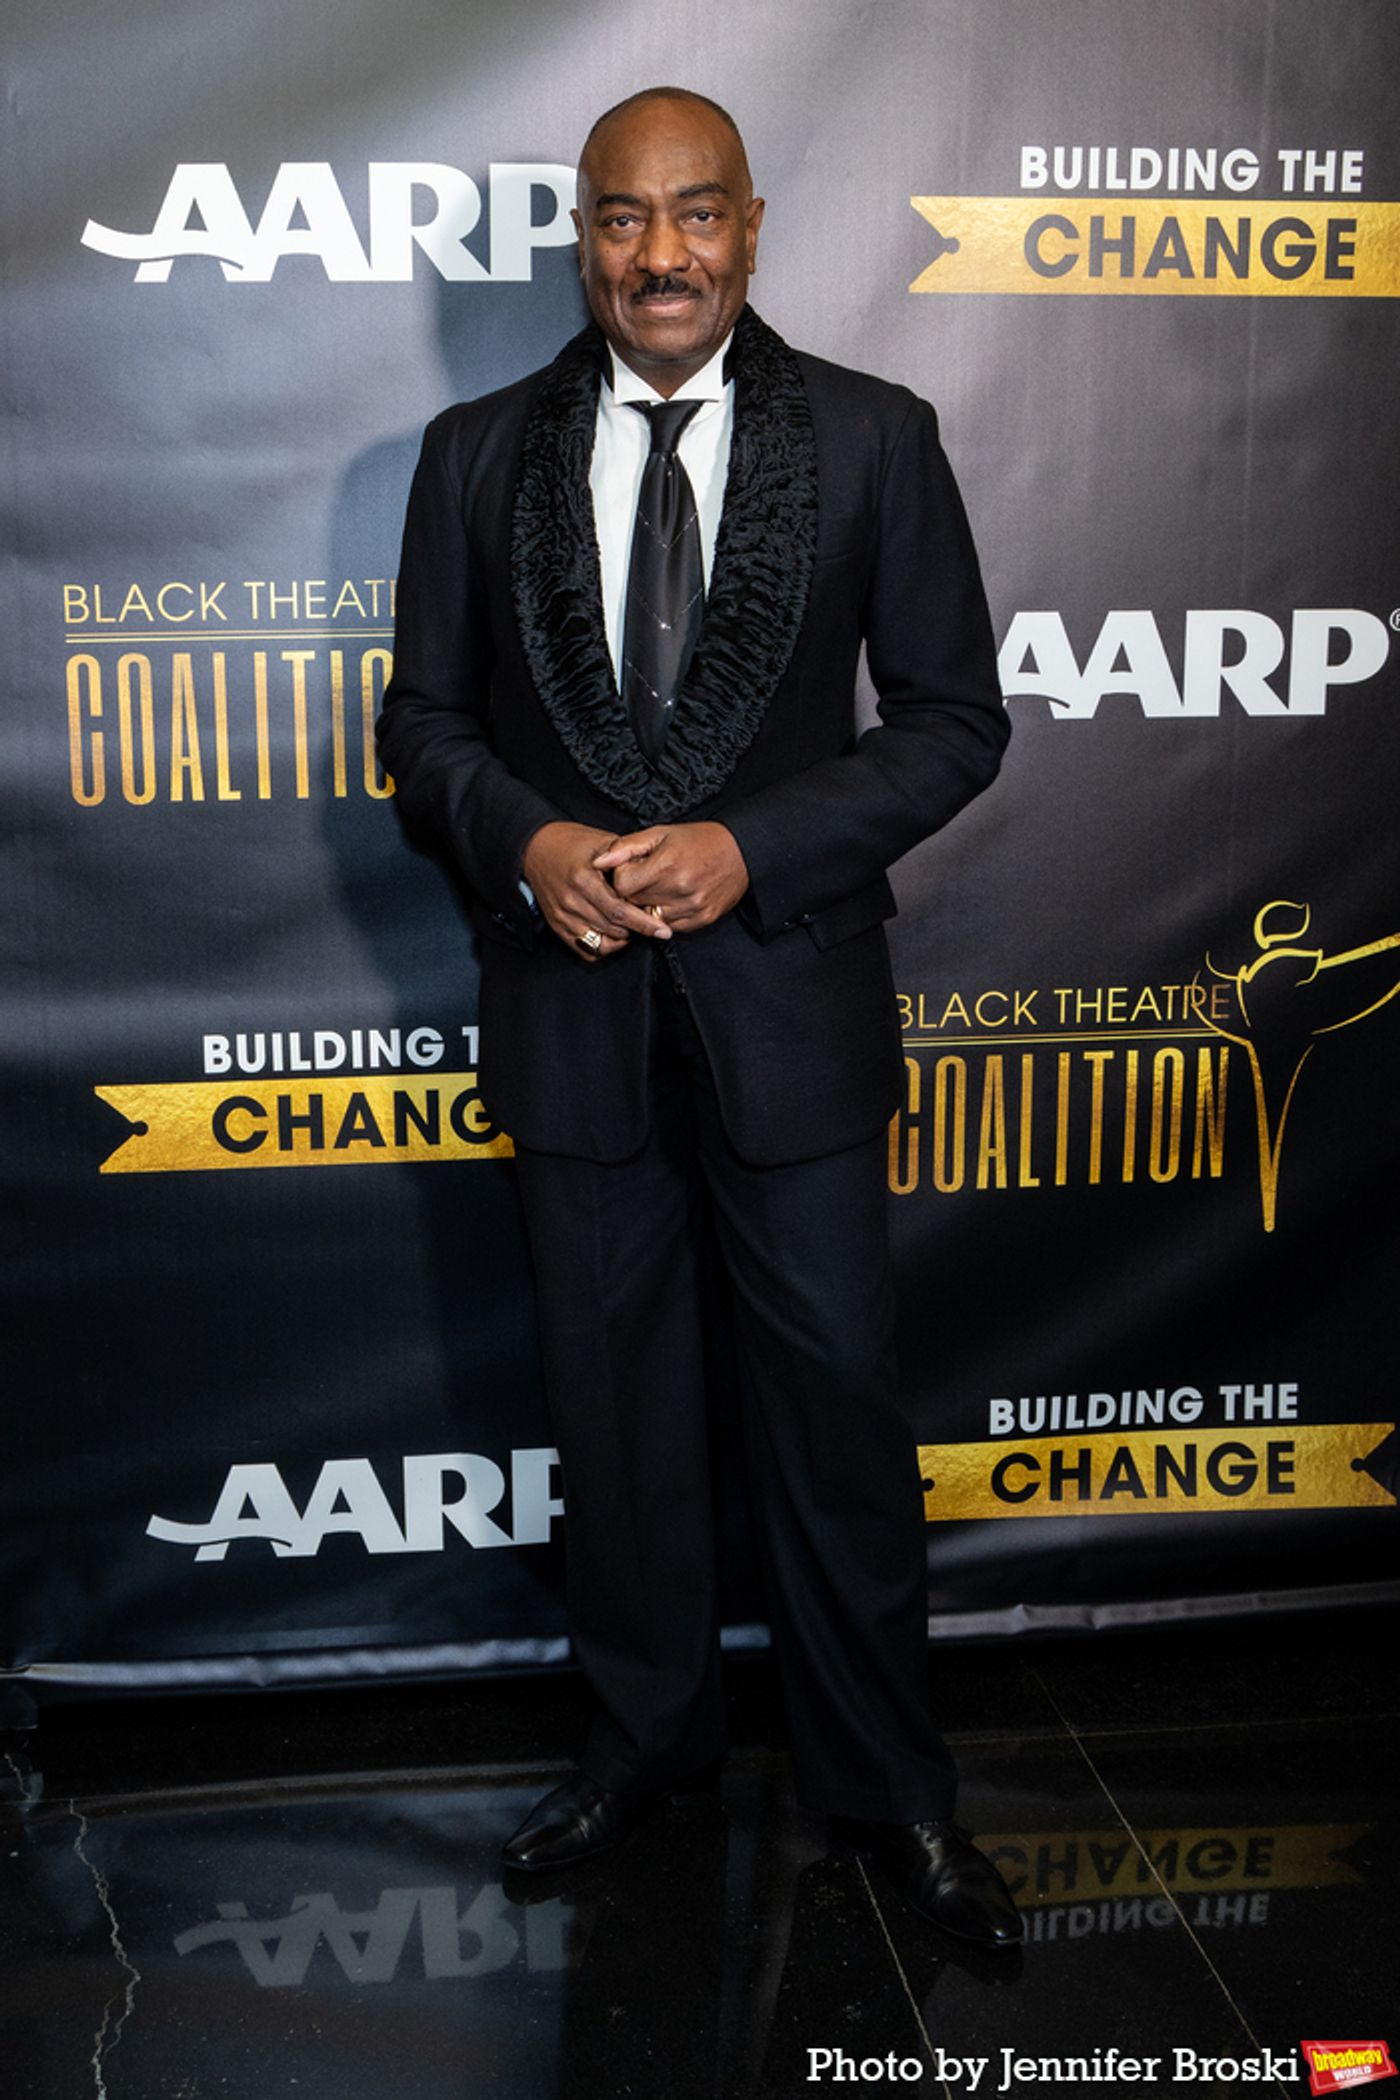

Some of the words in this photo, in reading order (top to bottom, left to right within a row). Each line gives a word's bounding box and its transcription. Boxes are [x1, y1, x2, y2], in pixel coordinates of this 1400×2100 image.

[1019, 146, 1260, 192] BUILDING
[1278, 149, 1364, 193] THE
[80, 161, 578, 283] AARP
[1023, 213, 1358, 281] CHANGE
[63, 582, 227, 624] BLACK
[243, 579, 396, 620] THEAT
[65, 648, 396, 807] COALITIO
[896, 989, 1040, 1030] BLACK
[1054, 983, 1231, 1025] THEATRE
[203, 1026, 445, 1074] BUILDING
[211, 1086, 502, 1154] CHANG
[887, 1045, 1230, 1196] COALITION
[989, 1386, 1203, 1435] BUILDING
[1219, 1383, 1298, 1421] THE
[990, 1441, 1295, 1503] CHANGE
